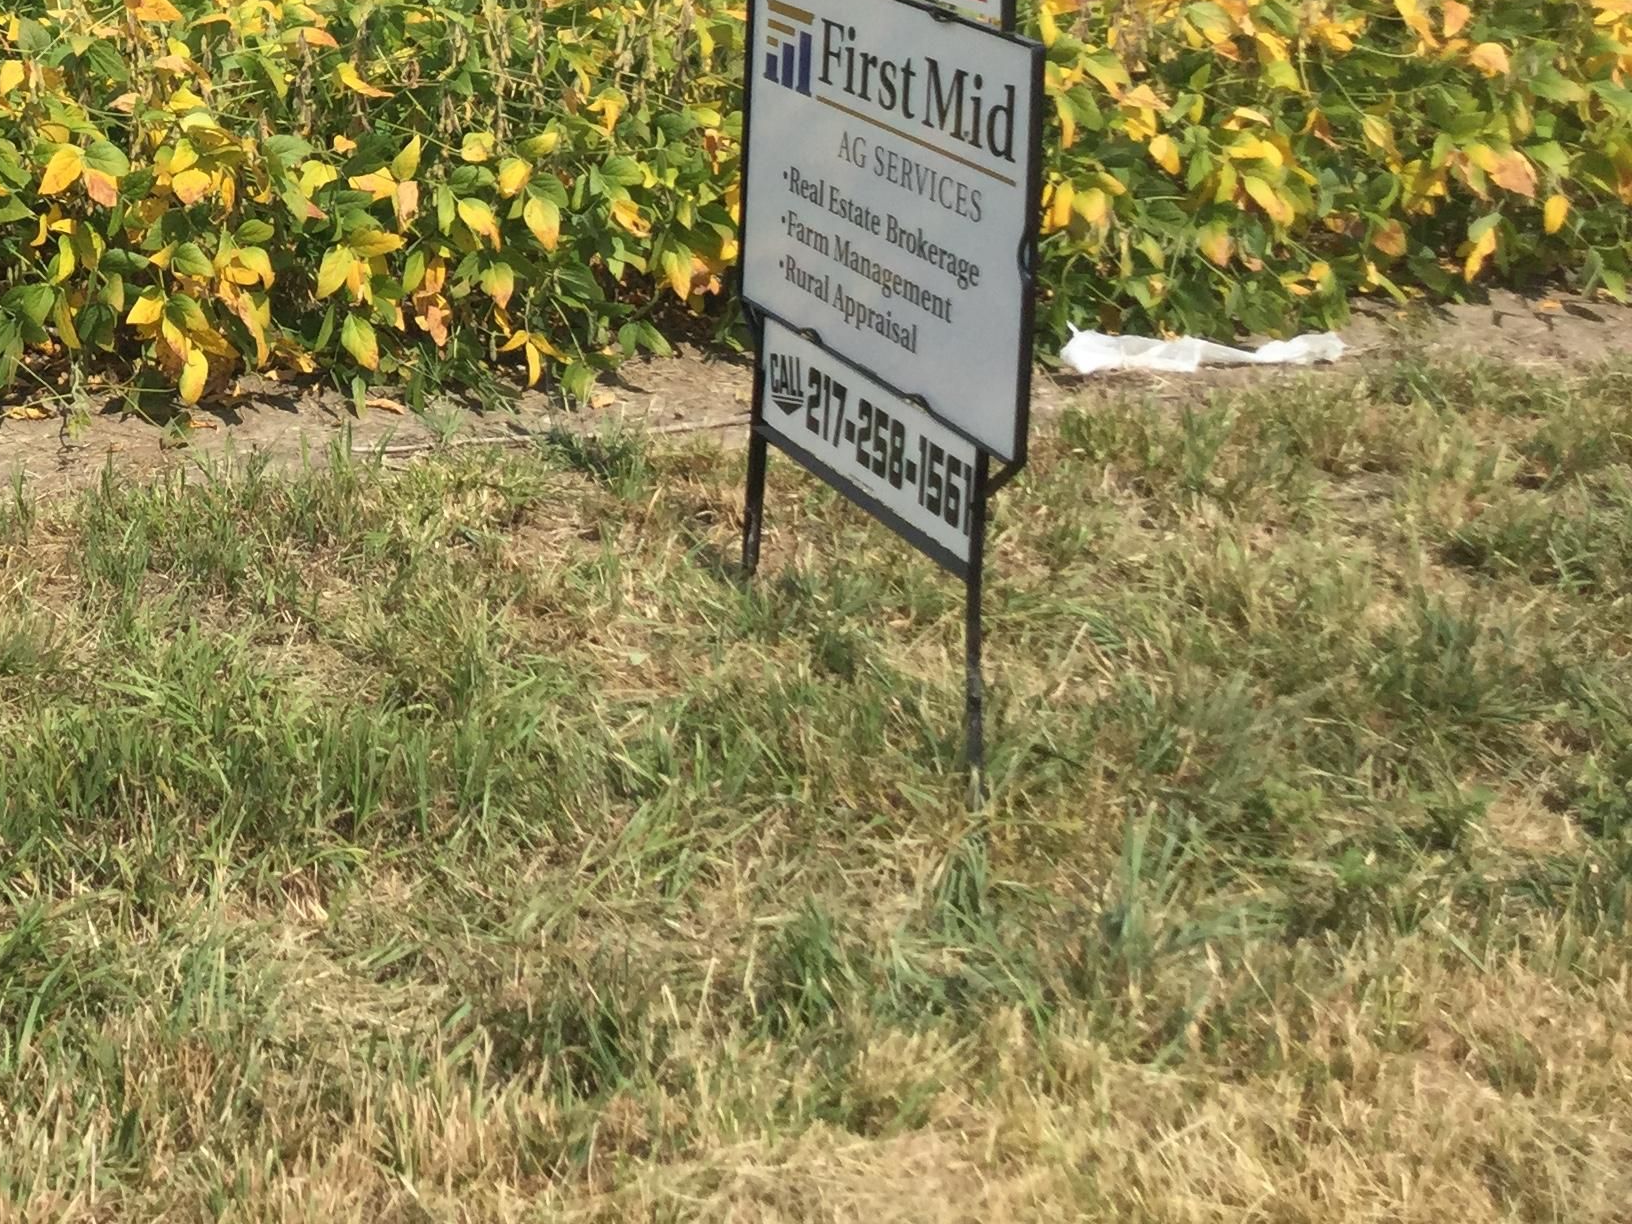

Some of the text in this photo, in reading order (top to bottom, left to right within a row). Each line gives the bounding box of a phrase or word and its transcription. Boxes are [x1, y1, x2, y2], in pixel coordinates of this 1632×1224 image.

[837, 131, 982, 223] AG SERVICES
[829, 185, 881, 236] Estate
[885, 214, 980, 290] Brokerage
[833, 235, 953, 324] Management
[832, 283, 917, 354] Appraisal
[770, 353, 804, 397] CALL
